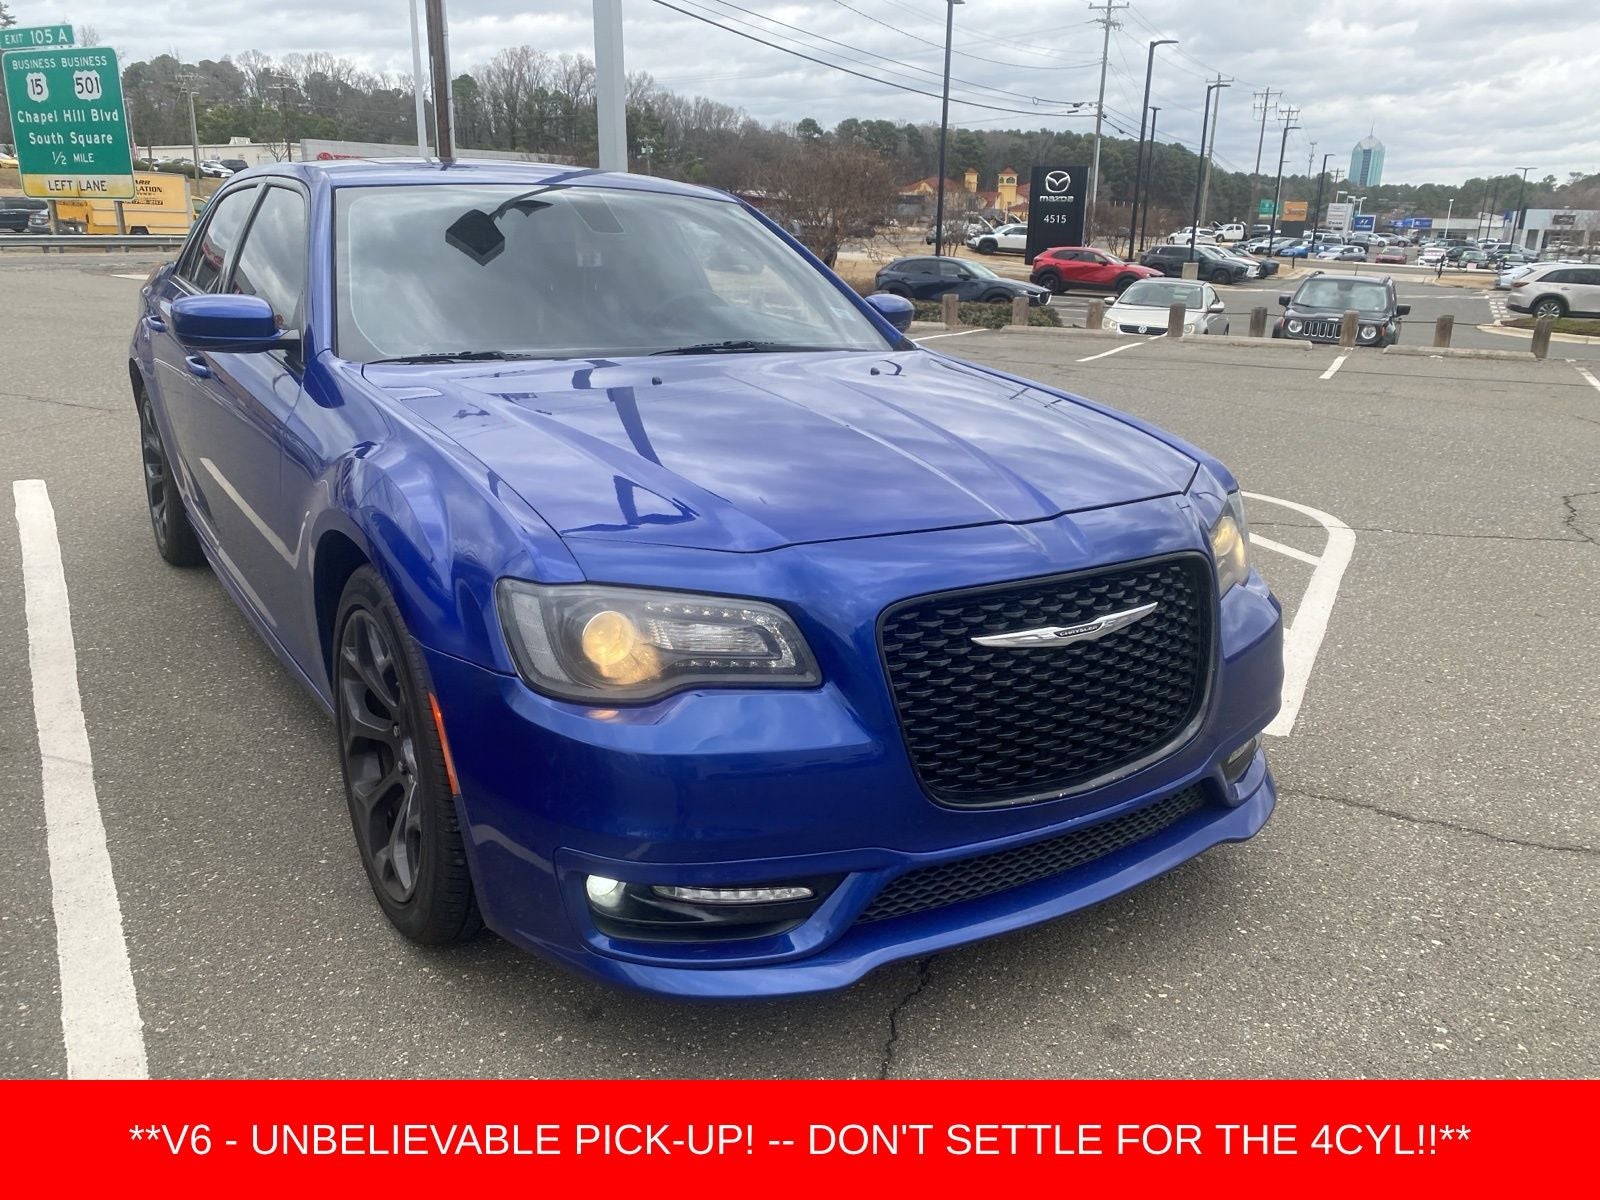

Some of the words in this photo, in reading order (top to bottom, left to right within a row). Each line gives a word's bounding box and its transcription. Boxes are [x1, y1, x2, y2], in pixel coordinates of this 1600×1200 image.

[5, 34, 23, 44] EXIT
[30, 29, 53, 44] 105
[58, 28, 68, 42] A
[12, 58, 56, 70] BUSINESS
[61, 56, 107, 68] BUSINESS
[30, 79, 44, 96] 15
[75, 77, 100, 95] 501
[17, 110, 58, 125] Chapel
[63, 109, 86, 122] Hill
[91, 108, 119, 122] Blvd
[29, 132, 64, 145] South
[70, 131, 113, 147] Square
[73, 153, 95, 163] MILE
[48, 180, 73, 191] LEFT
[79, 180, 108, 192] LANE
[1044, 214, 1067, 224] 4515
